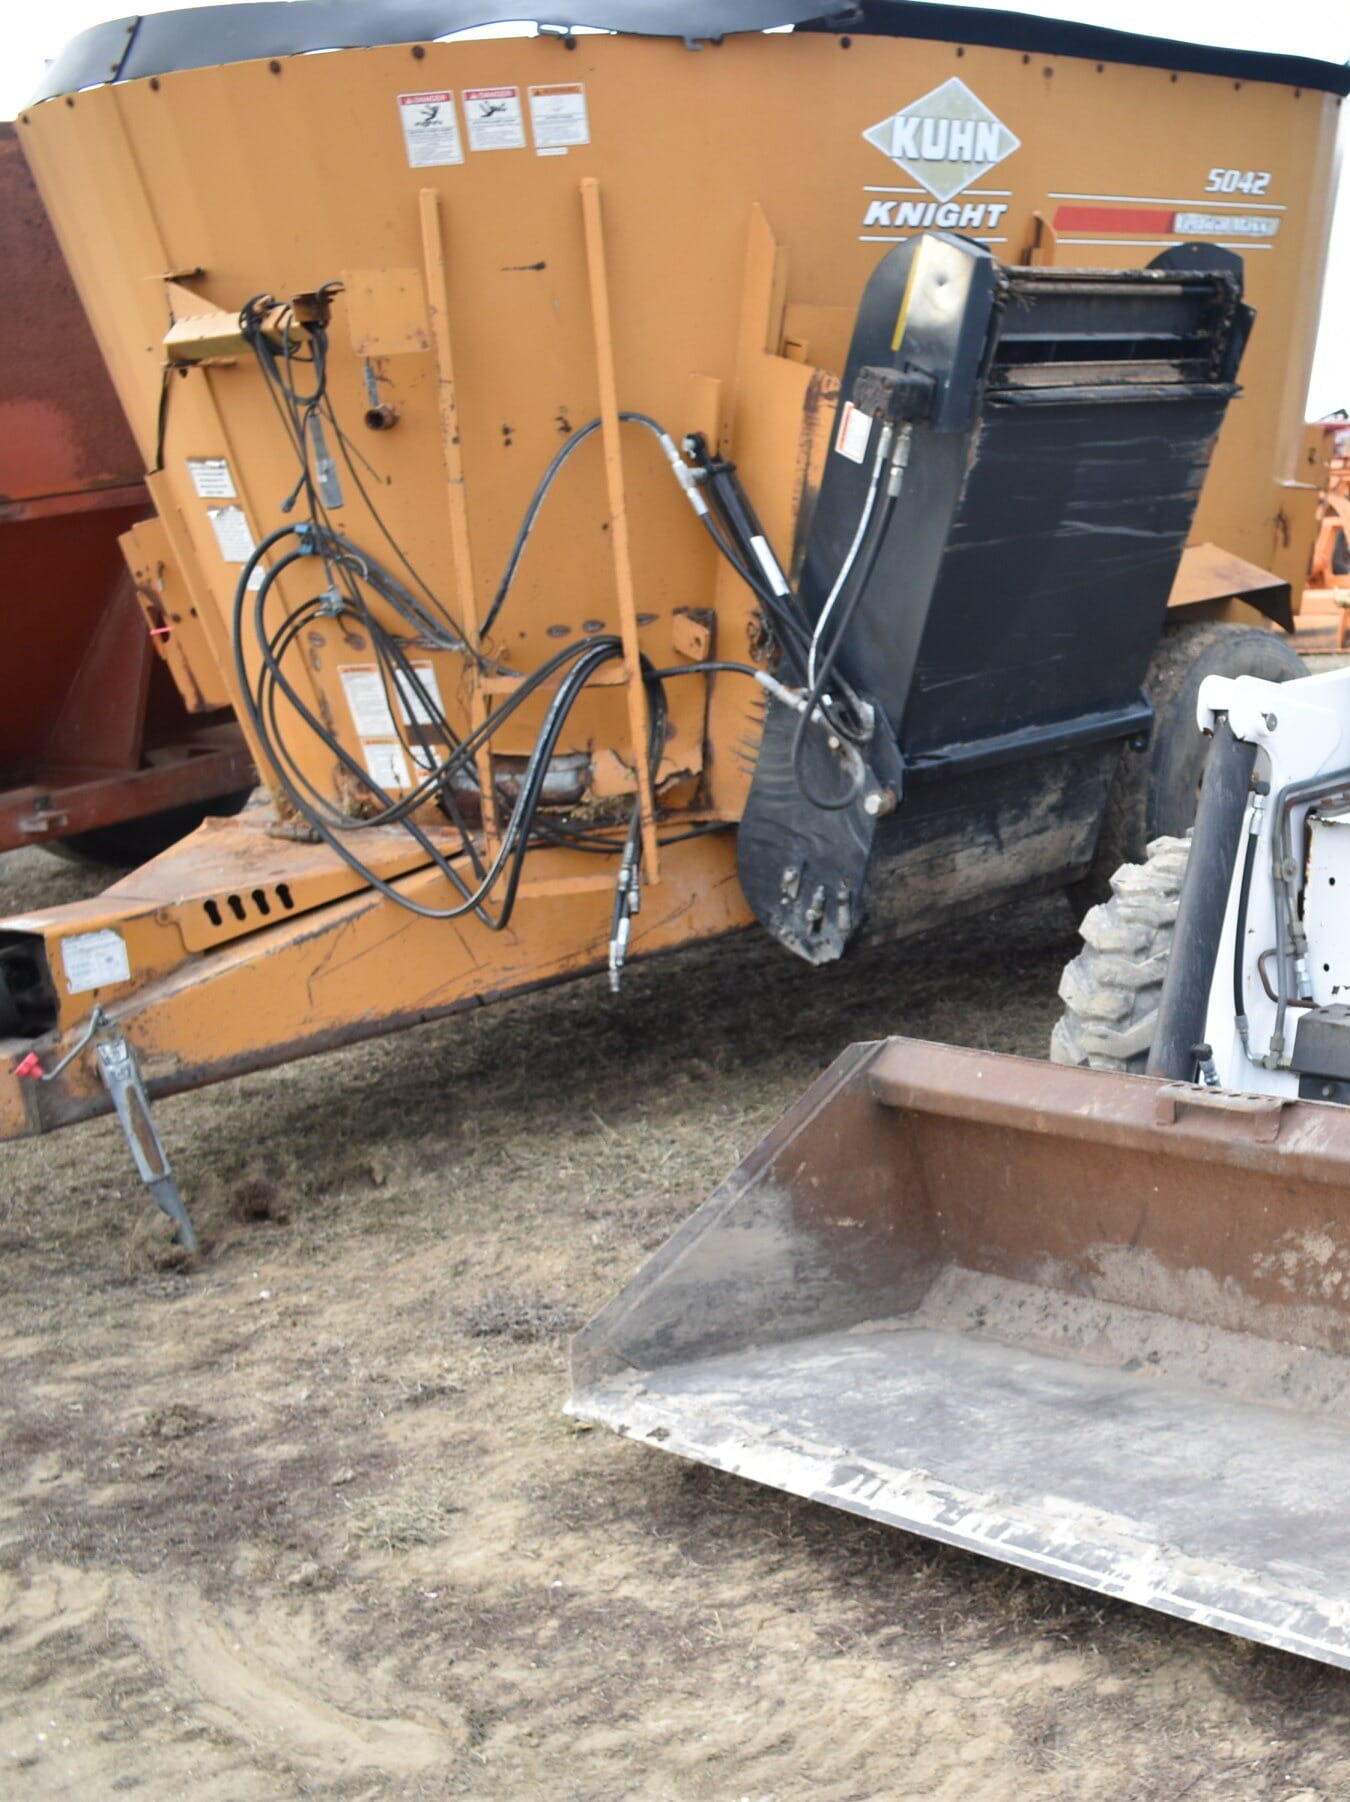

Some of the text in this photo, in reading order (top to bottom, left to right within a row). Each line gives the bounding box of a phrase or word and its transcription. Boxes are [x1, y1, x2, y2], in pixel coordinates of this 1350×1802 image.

[891, 115, 1002, 163] KUHN
[1203, 167, 1272, 196] 5042
[863, 200, 1008, 228] KNIGHT
